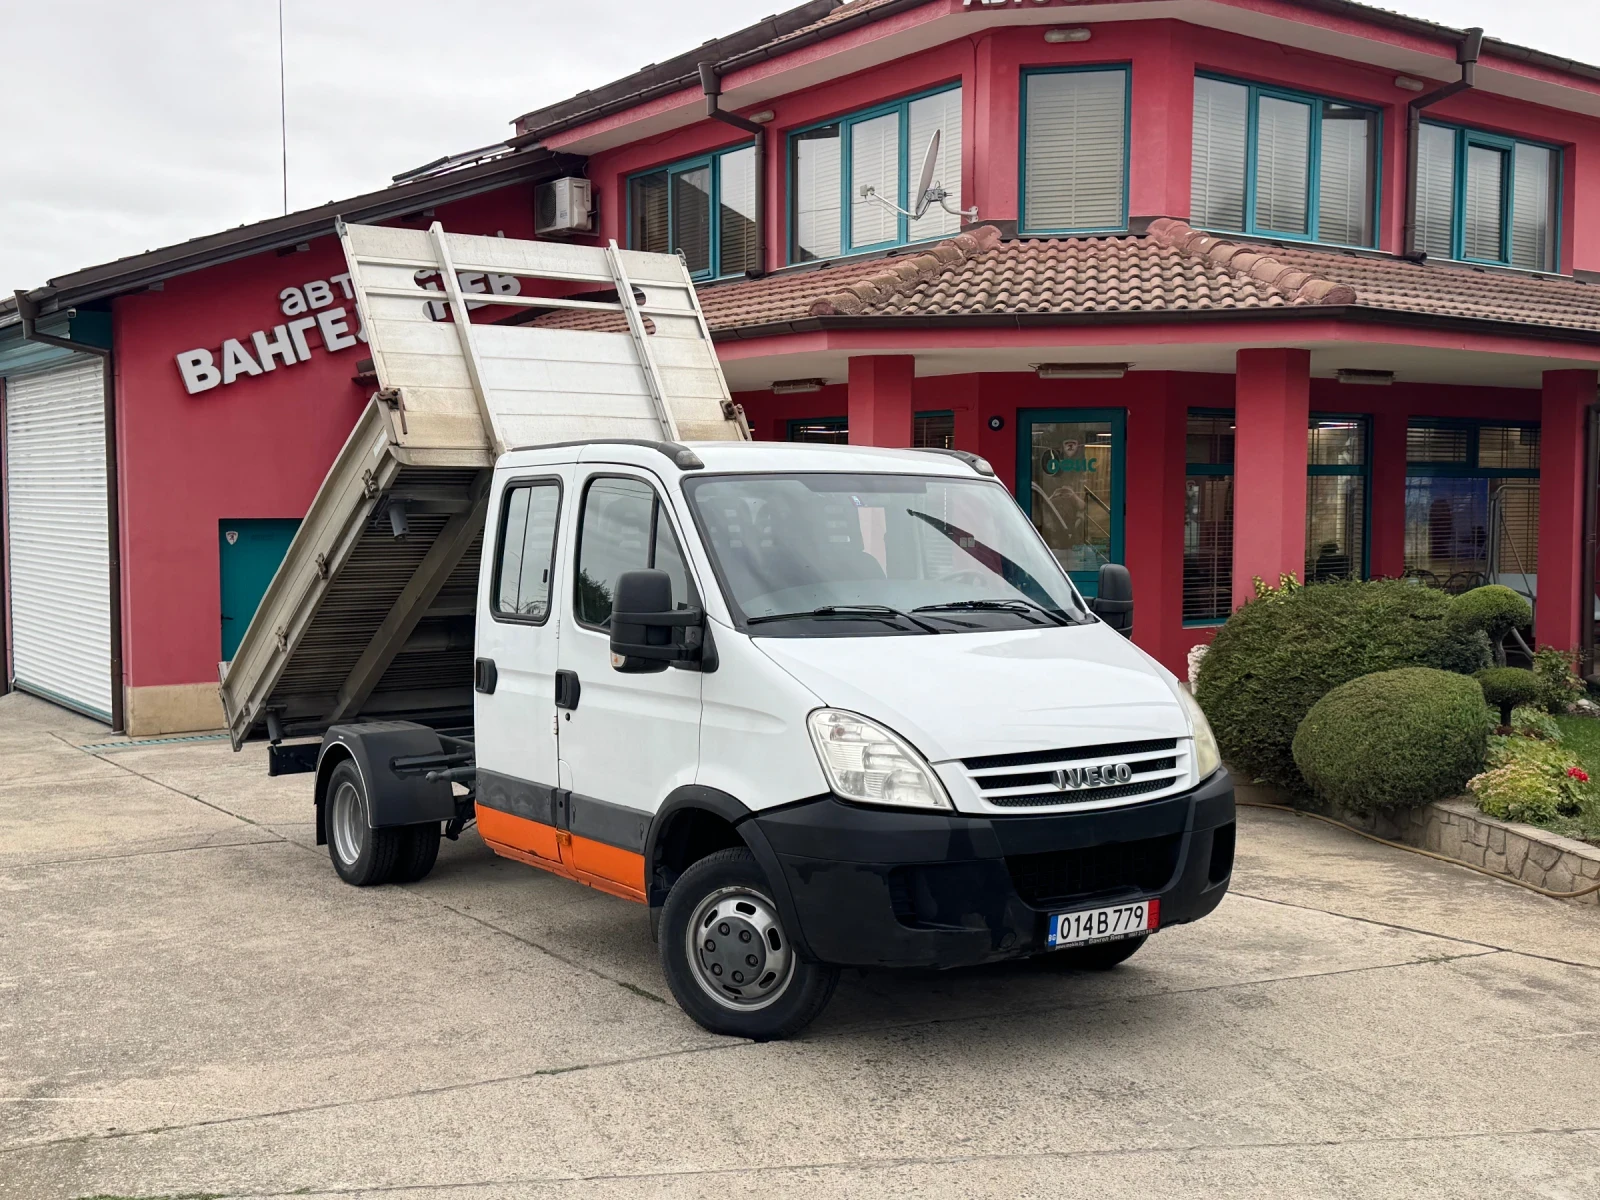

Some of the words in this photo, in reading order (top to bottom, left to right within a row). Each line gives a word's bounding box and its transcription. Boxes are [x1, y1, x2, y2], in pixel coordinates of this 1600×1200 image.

[175, 304, 369, 394] ВАНГЕ
[1055, 763, 1132, 789] IVECO
[1060, 905, 1144, 940] 014B779
